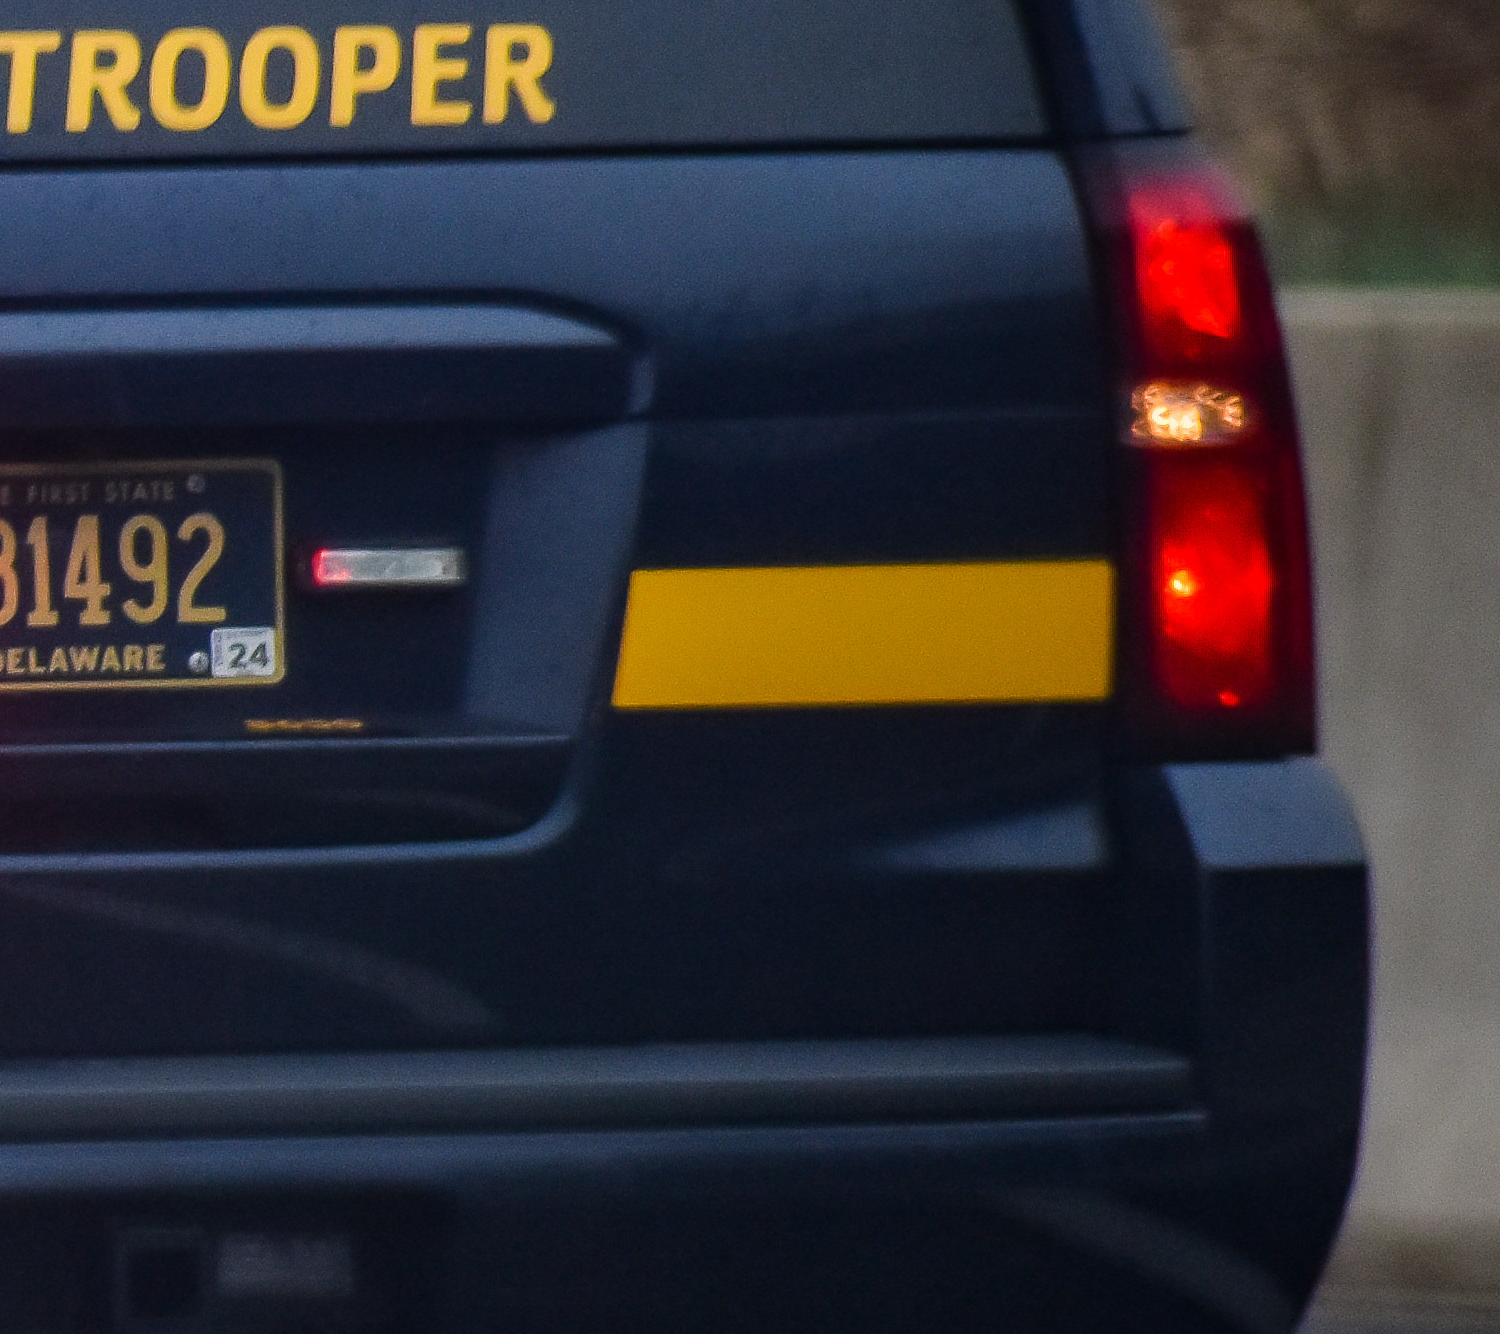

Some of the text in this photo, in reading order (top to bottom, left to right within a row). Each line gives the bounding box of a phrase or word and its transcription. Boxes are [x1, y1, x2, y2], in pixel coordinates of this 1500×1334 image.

[27, 482, 90, 504] FIRST
[105, 480, 175, 503] STATE
[227, 642, 270, 669] 24
